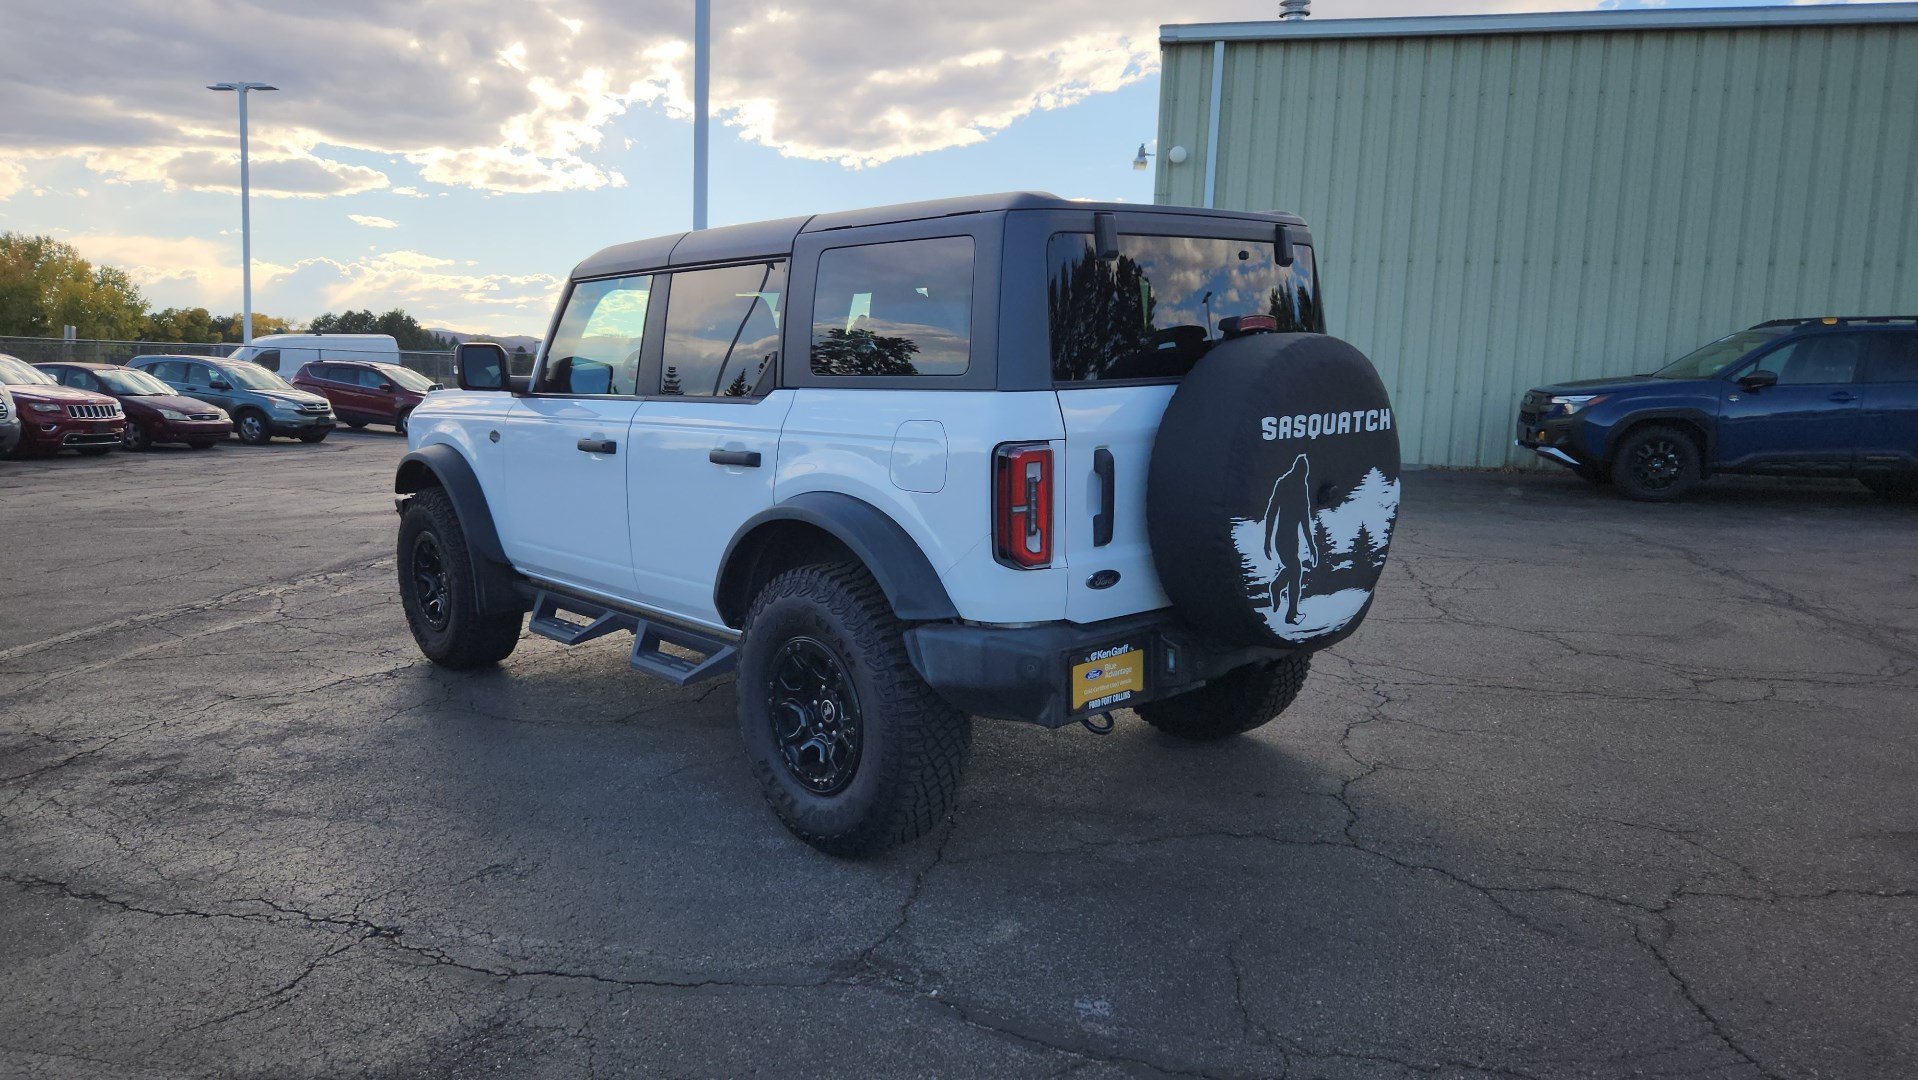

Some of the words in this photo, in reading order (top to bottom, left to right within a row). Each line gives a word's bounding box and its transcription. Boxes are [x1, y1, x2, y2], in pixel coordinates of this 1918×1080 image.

[1261, 408, 1391, 441] SASQUATCH
[1097, 650, 1111, 660] Ken
[1111, 644, 1129, 656] Garff
[1086, 669, 1102, 680] Ford
[1088, 699, 1101, 709] FORD
[1101, 696, 1112, 705] FORT
[1113, 691, 1130, 702] COLLINS
